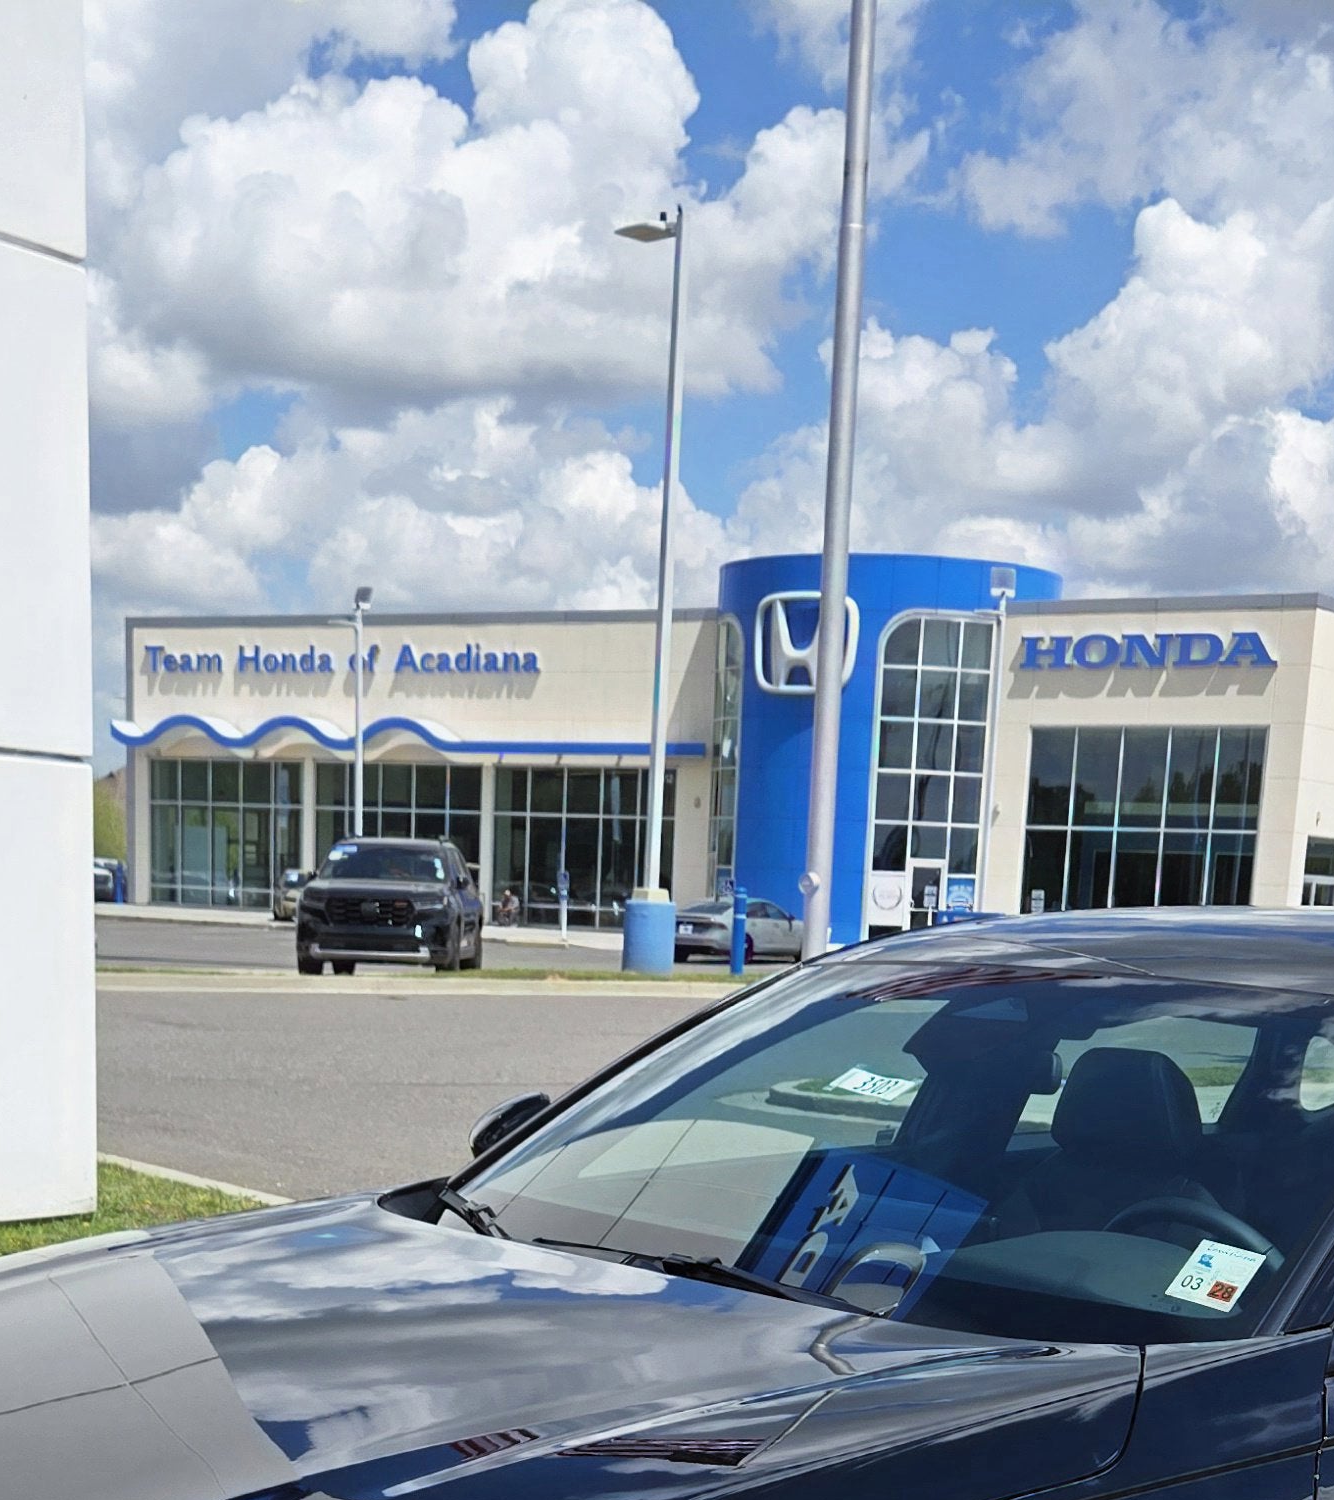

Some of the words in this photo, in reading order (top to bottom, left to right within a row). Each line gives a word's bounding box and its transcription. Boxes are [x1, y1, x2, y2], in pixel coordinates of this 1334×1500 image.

[144, 645, 222, 673] Team
[238, 644, 333, 673] Honda
[394, 643, 539, 674] Acadiana
[1019, 631, 1278, 670] HONDA
[1181, 1274, 1204, 1291] 03
[1212, 1282, 1235, 1300] 28
